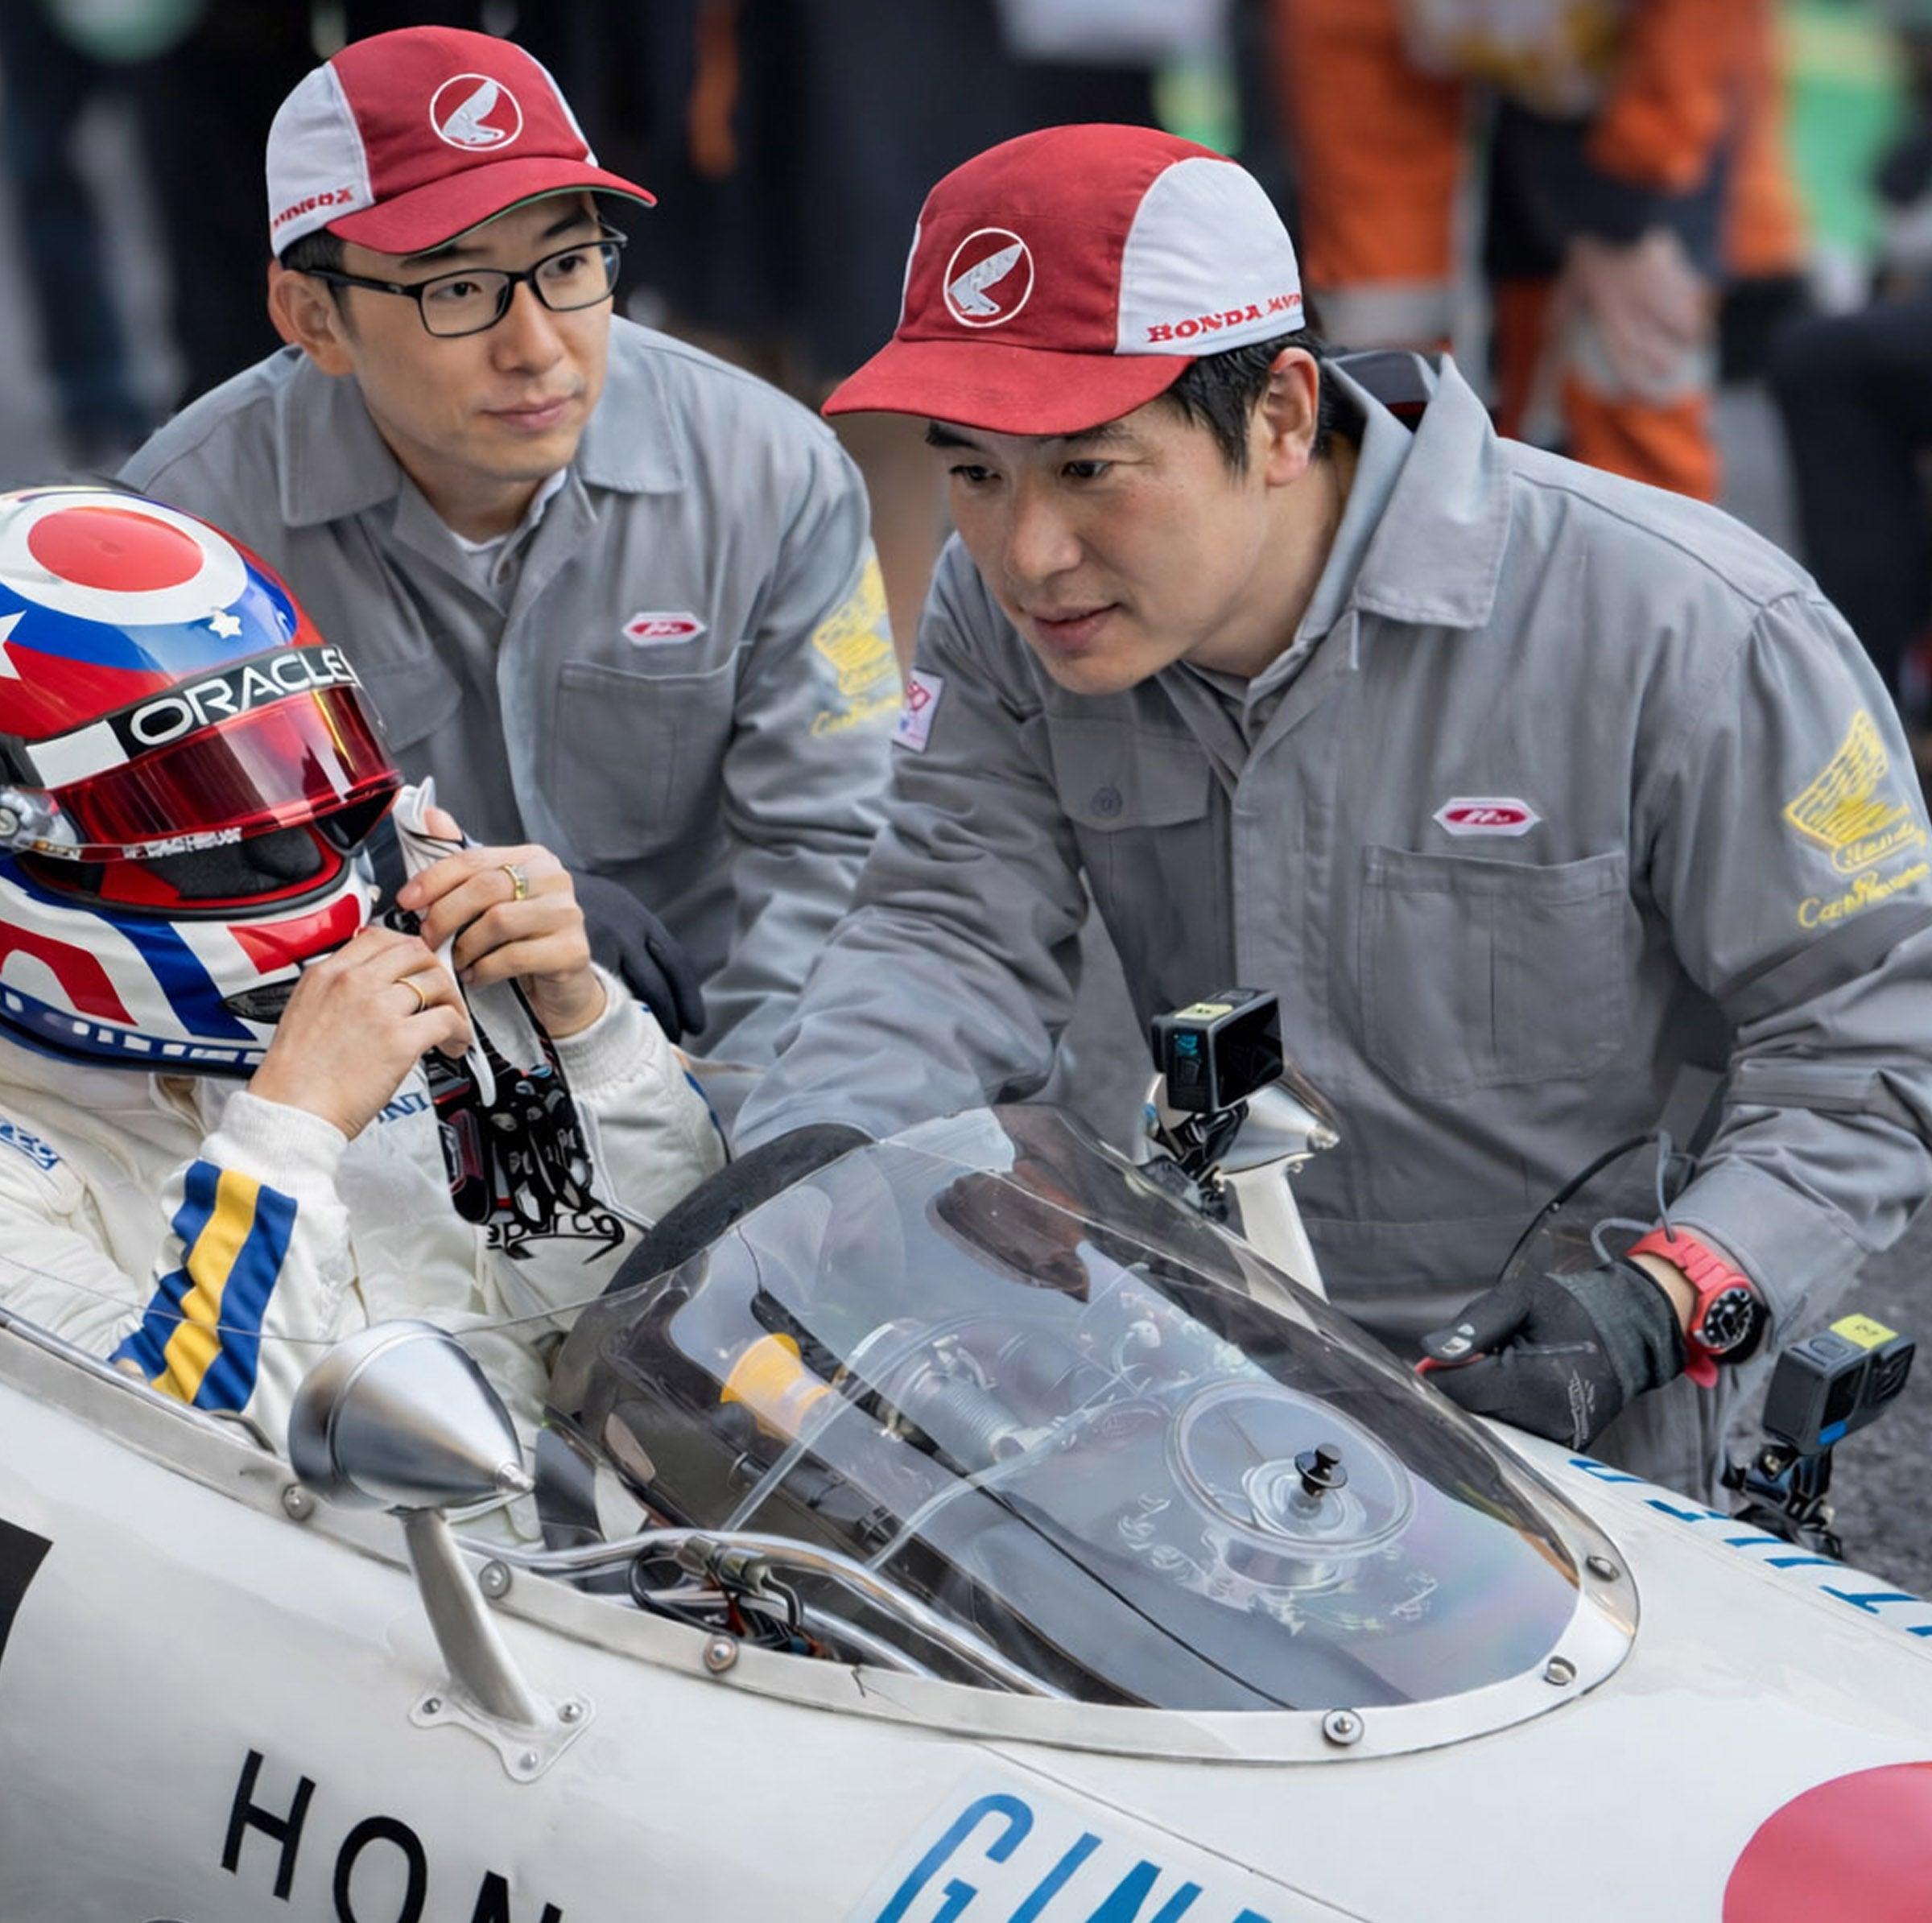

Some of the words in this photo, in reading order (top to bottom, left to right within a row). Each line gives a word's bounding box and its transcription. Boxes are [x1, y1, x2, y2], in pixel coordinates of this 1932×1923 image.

[1147, 304, 1262, 342] HONDA
[130, 647, 355, 745] ORACLE
[874, 1793, 1272, 1923] GI
